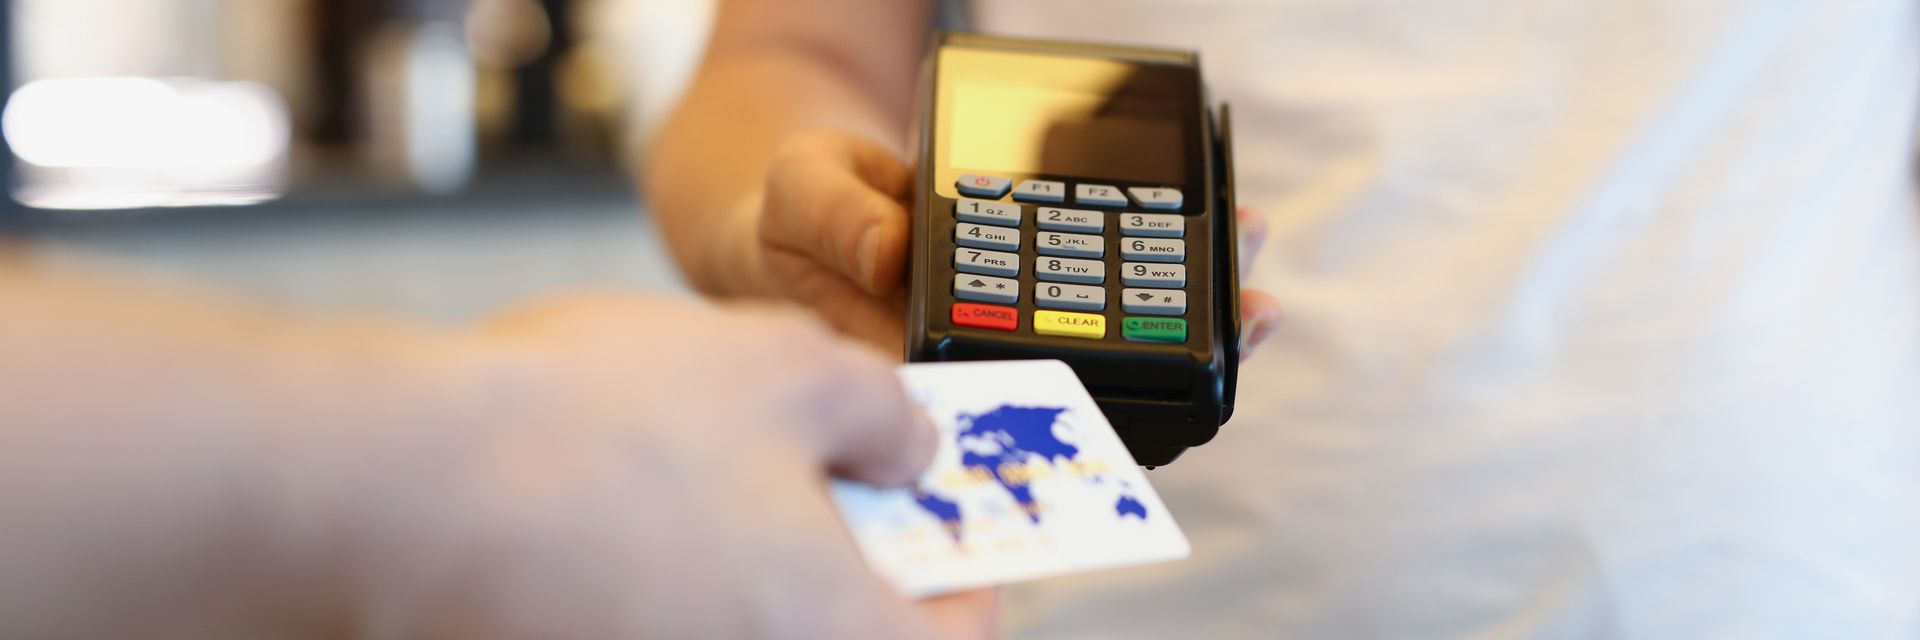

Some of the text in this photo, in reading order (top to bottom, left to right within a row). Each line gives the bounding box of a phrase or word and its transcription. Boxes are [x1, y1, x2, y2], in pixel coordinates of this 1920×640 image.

[1032, 183, 1051, 192] F1
[1089, 187, 1109, 197] F2
[970, 202, 979, 213] 1
[1048, 210, 1061, 221] 2
[1131, 216, 1144, 227] 3
[968, 227, 1006, 241] 4 GHI
[1048, 234, 1062, 246] 5
[1132, 240, 1145, 252] 6
[967, 251, 1007, 267] 7 PRS
[1048, 260, 1089, 274] 8 TUV
[1134, 265, 1147, 277] 9
[973, 308, 1014, 322] CANCEL
[1058, 316, 1099, 327] CLEAR
[1143, 322, 1183, 331] ENTER
